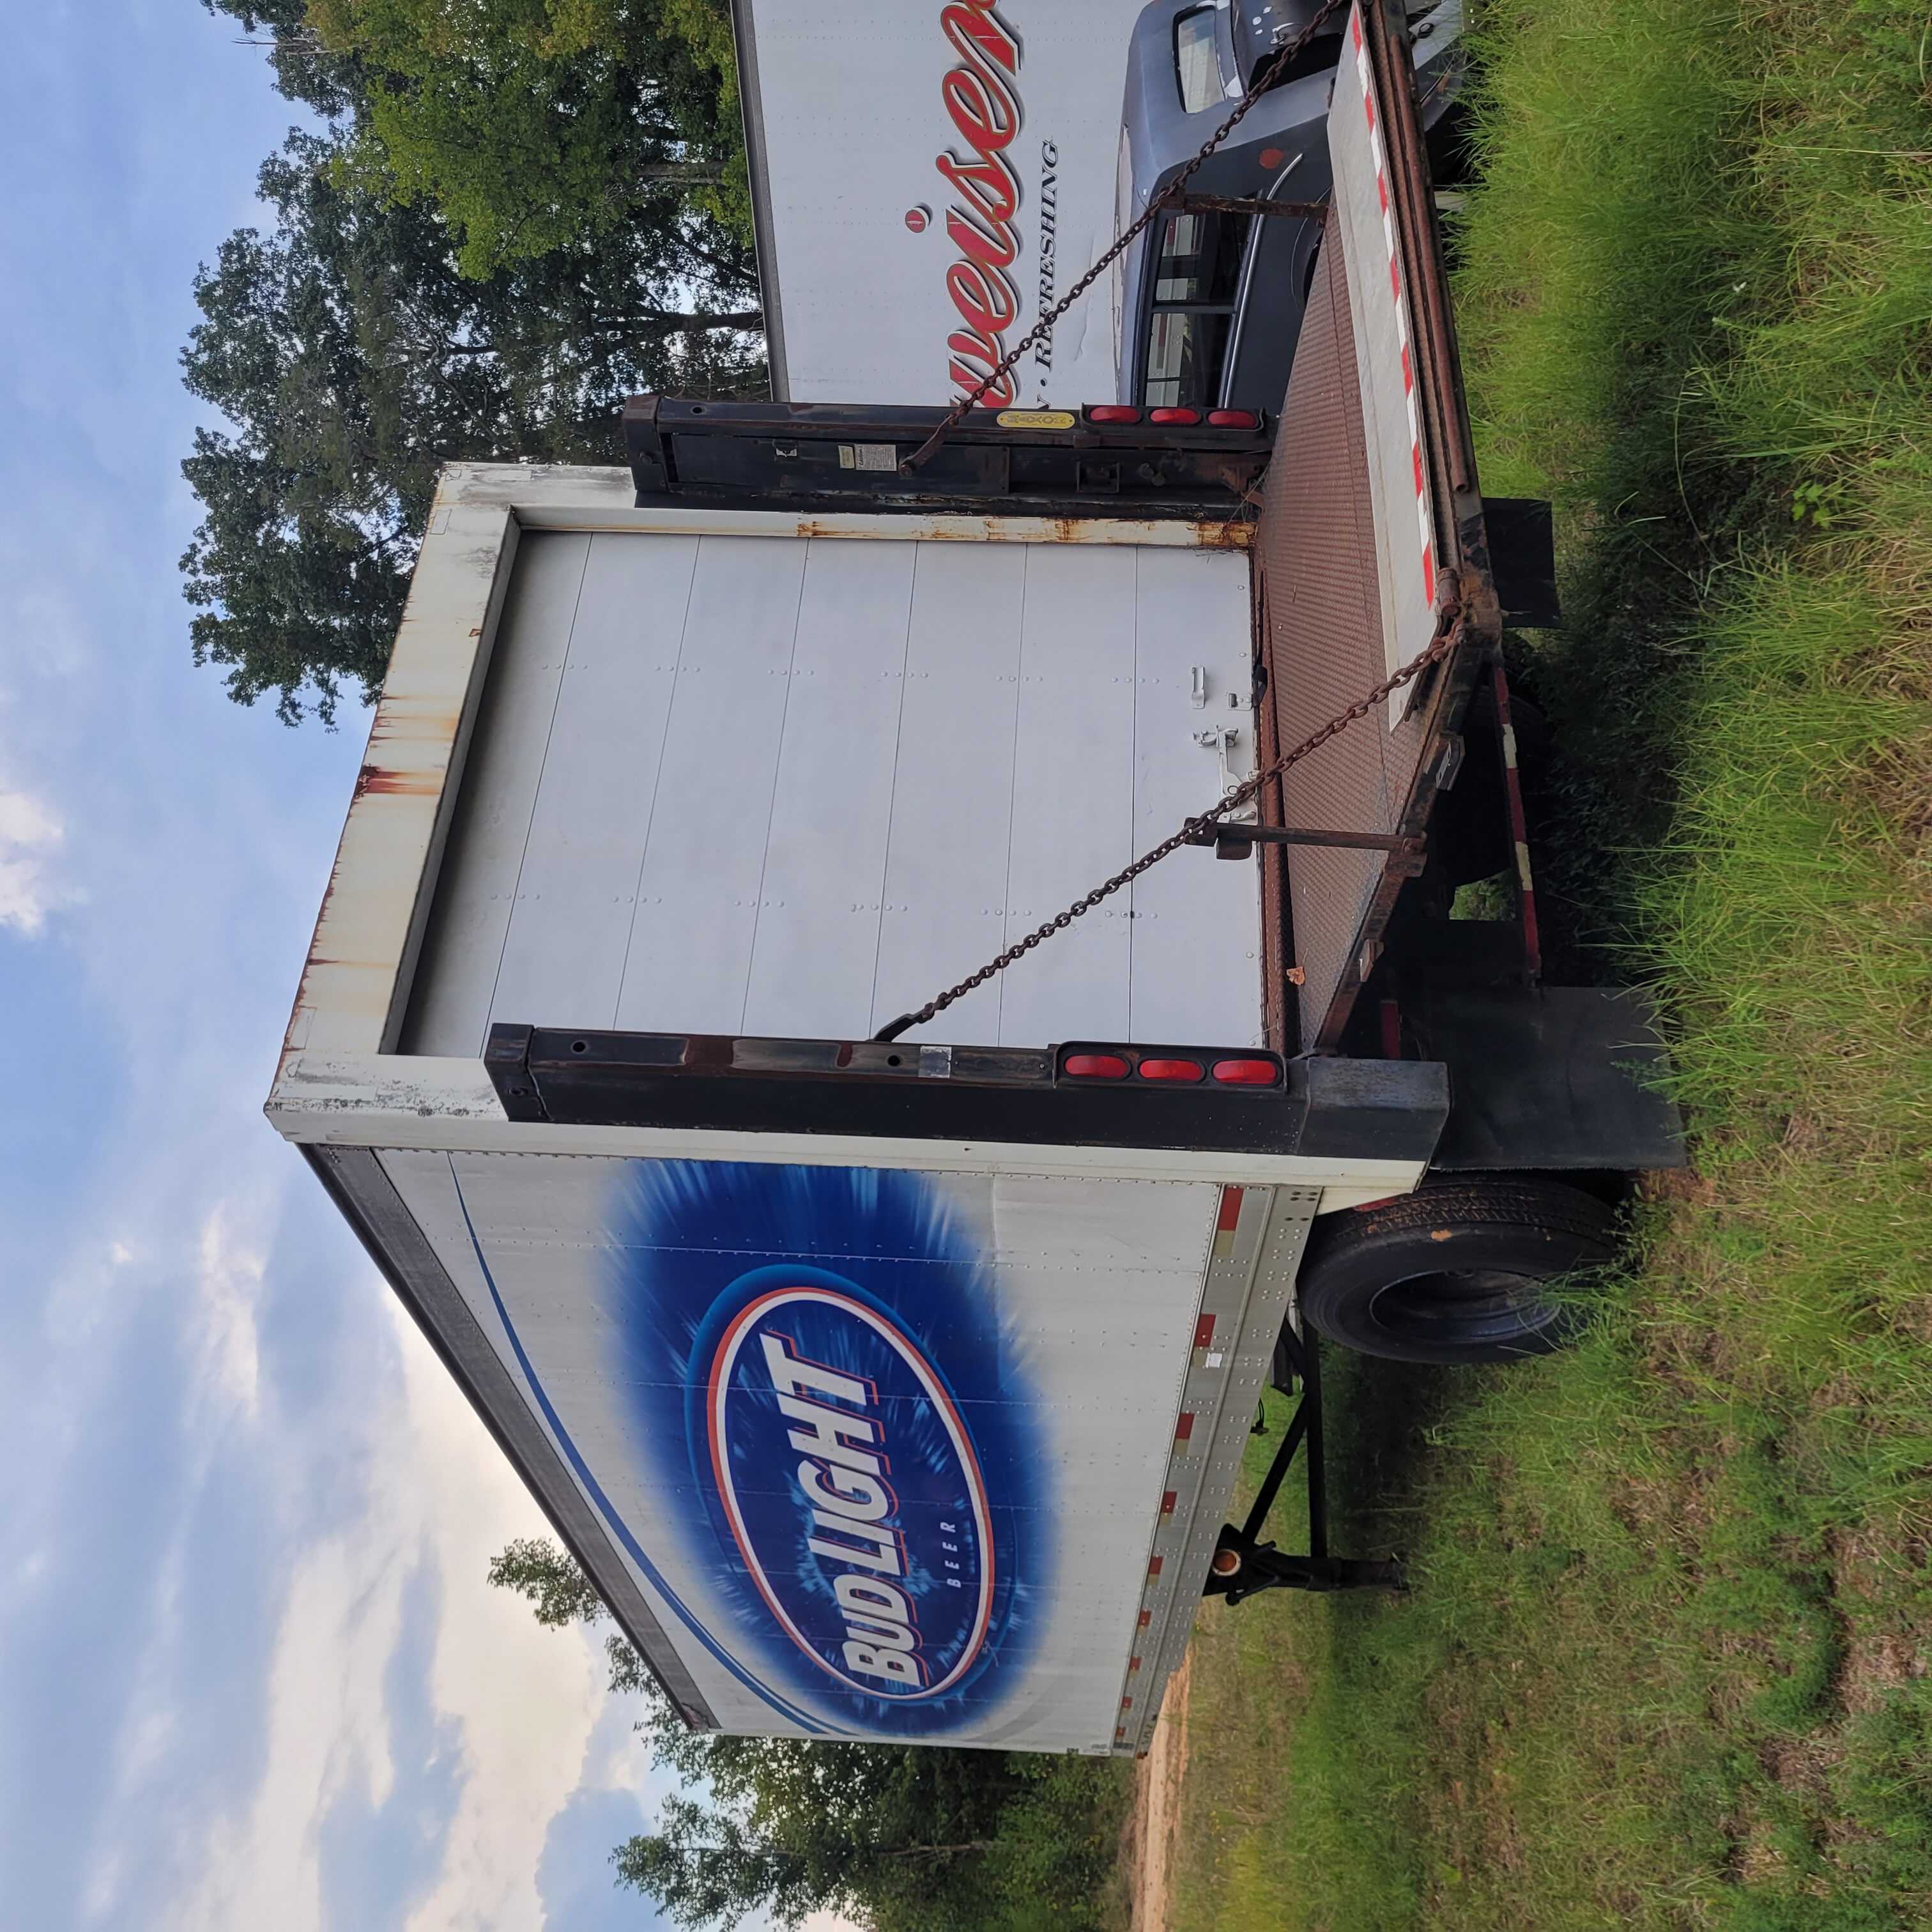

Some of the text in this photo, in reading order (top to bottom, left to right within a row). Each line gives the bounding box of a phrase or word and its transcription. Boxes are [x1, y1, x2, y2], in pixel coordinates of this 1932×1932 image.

[1034, 137, 1059, 373] REFRESHING
[759, 1330, 929, 1687] BUD LIGHT
[940, 1521, 961, 1588] BEER
